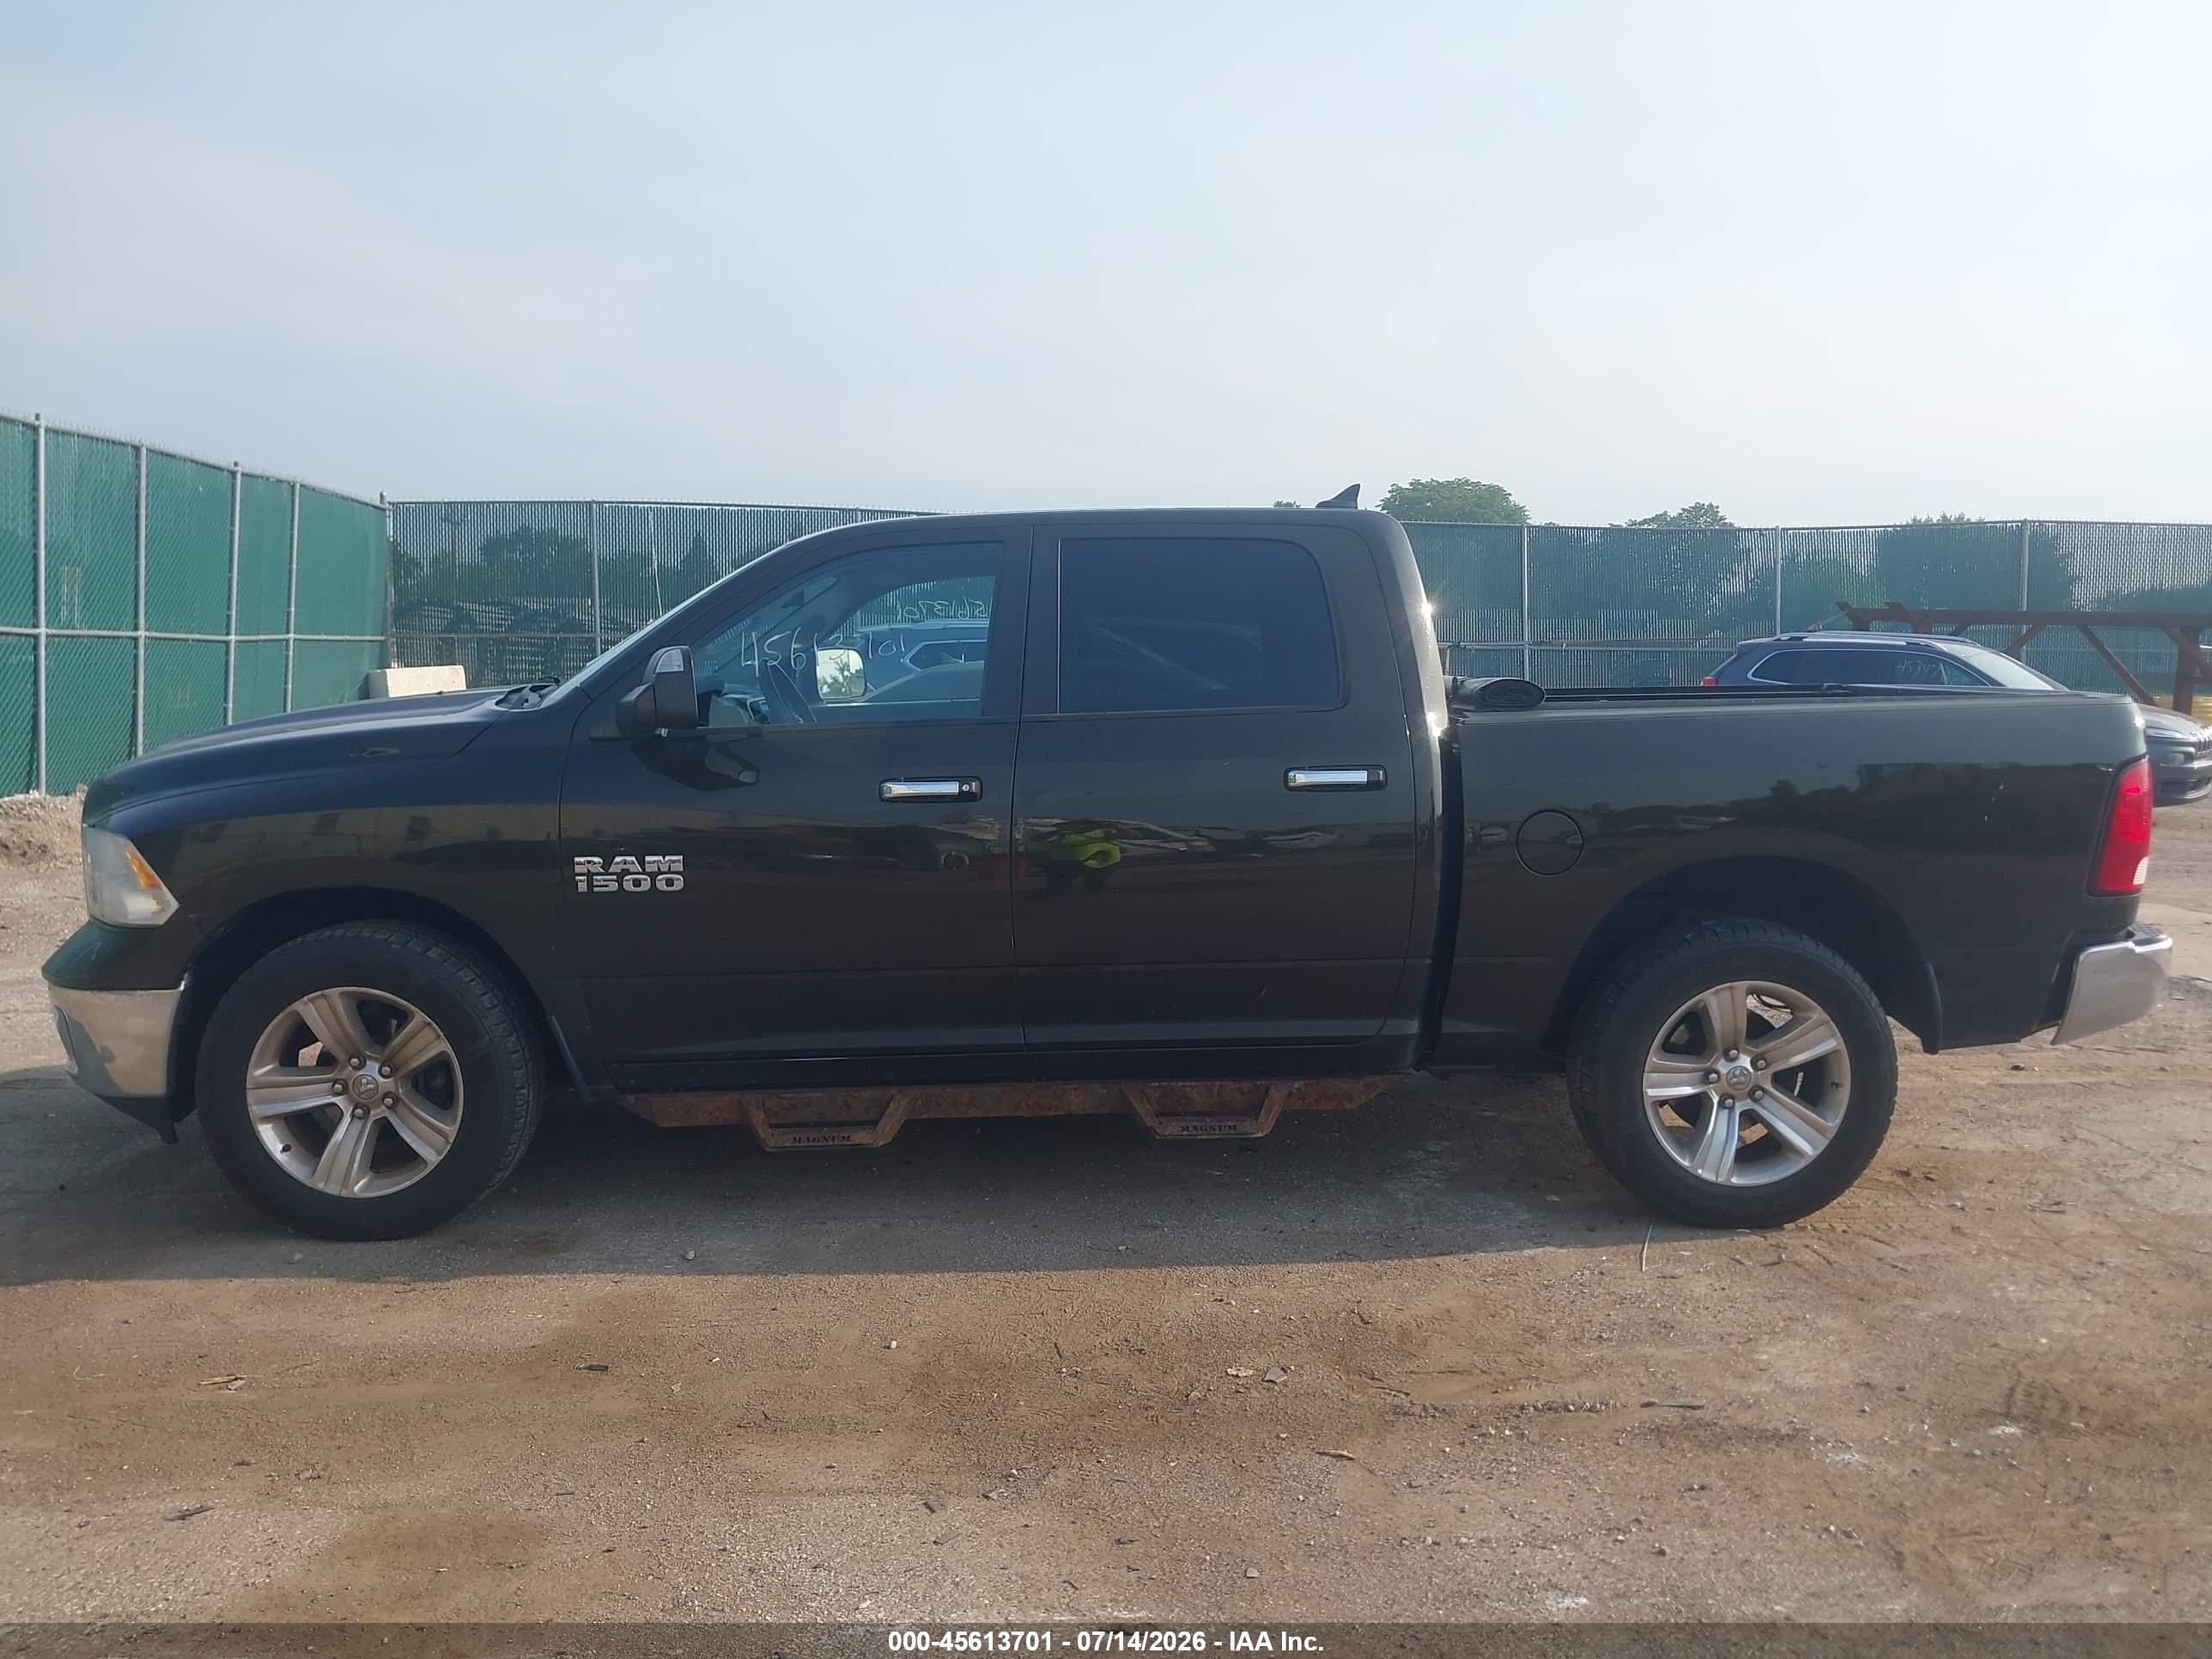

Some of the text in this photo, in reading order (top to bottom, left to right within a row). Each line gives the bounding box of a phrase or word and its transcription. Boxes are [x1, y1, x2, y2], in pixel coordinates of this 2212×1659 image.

[741, 627, 906, 677] 45613701
[574, 855, 684, 872] RAM
[574, 874, 684, 892] 1500
[1180, 1124, 1237, 1133] MAGNUM
